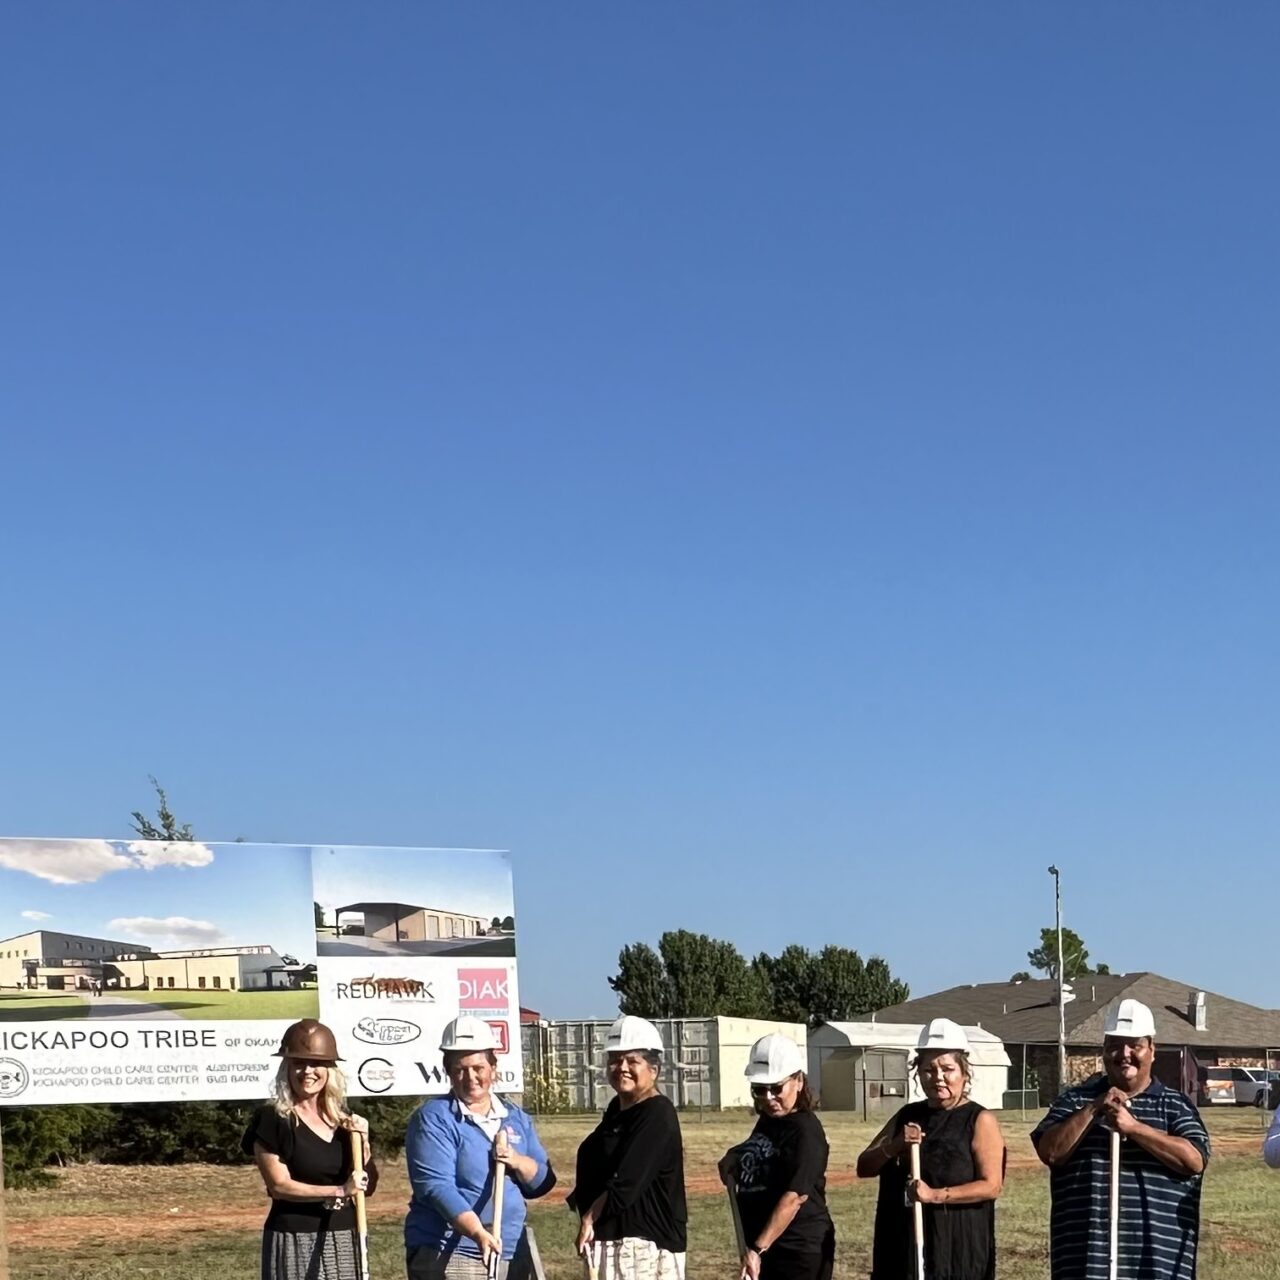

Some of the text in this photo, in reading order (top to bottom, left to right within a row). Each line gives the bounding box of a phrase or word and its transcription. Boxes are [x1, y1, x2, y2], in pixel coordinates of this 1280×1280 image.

[336, 982, 435, 999] REDHAWK
[459, 980, 508, 999] DIAK
[0, 1030, 130, 1050] ICKAPOO
[137, 1029, 217, 1048] TRIBE
[224, 1038, 241, 1047] OF
